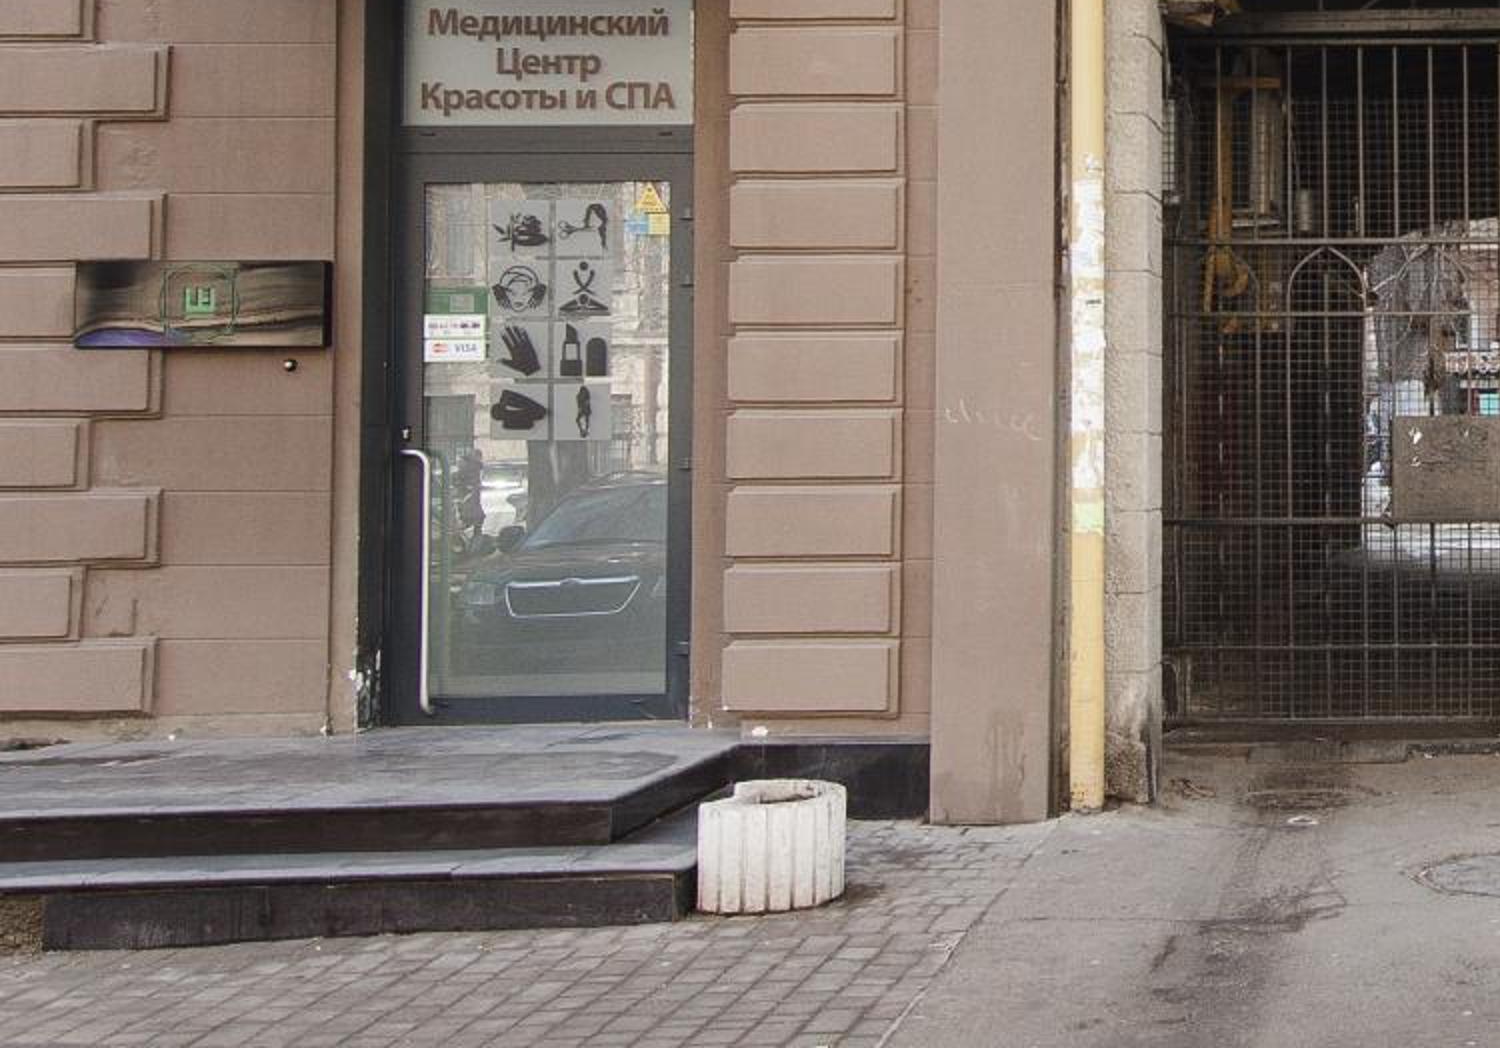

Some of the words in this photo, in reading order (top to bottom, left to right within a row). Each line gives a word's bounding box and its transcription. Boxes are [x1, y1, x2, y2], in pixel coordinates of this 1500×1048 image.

[427, 8, 670, 40] Медицинский
[496, 48, 601, 81] Центр
[420, 82, 566, 116] Красоты
[576, 90, 597, 109] и
[605, 82, 675, 109] СПА
